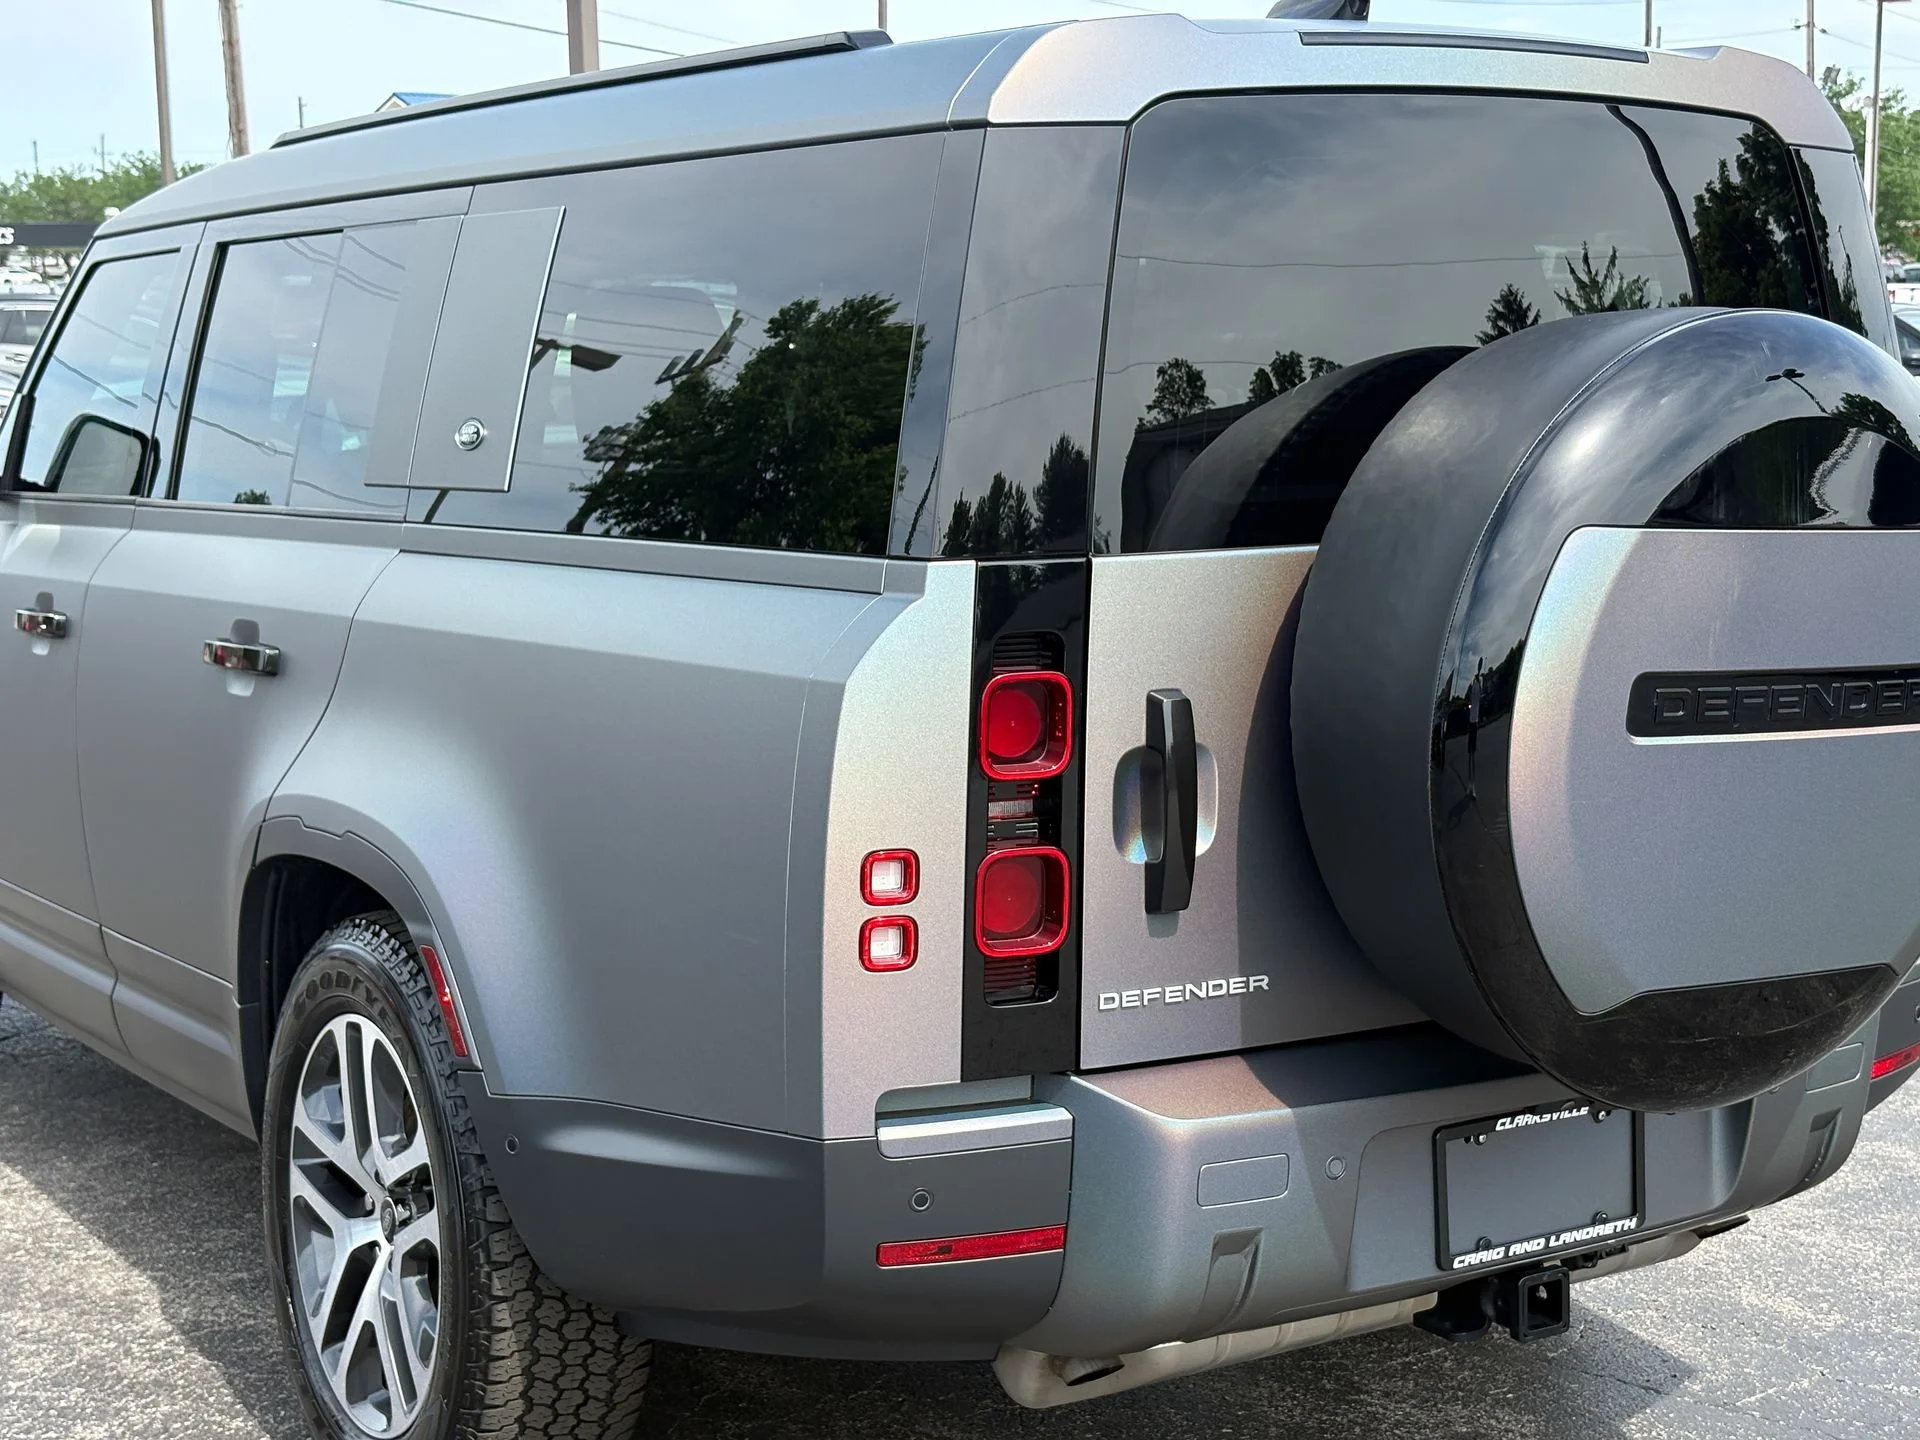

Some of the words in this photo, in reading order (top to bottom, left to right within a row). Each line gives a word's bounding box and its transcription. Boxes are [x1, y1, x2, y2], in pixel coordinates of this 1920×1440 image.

[1099, 975, 1270, 1010] DEFENDER
[1495, 1106, 1590, 1131] CLARKSVILLE
[1453, 1246, 1506, 1269] CRAIG
[1508, 1237, 1546, 1257] AND
[1549, 1217, 1637, 1248] LANDRETH
